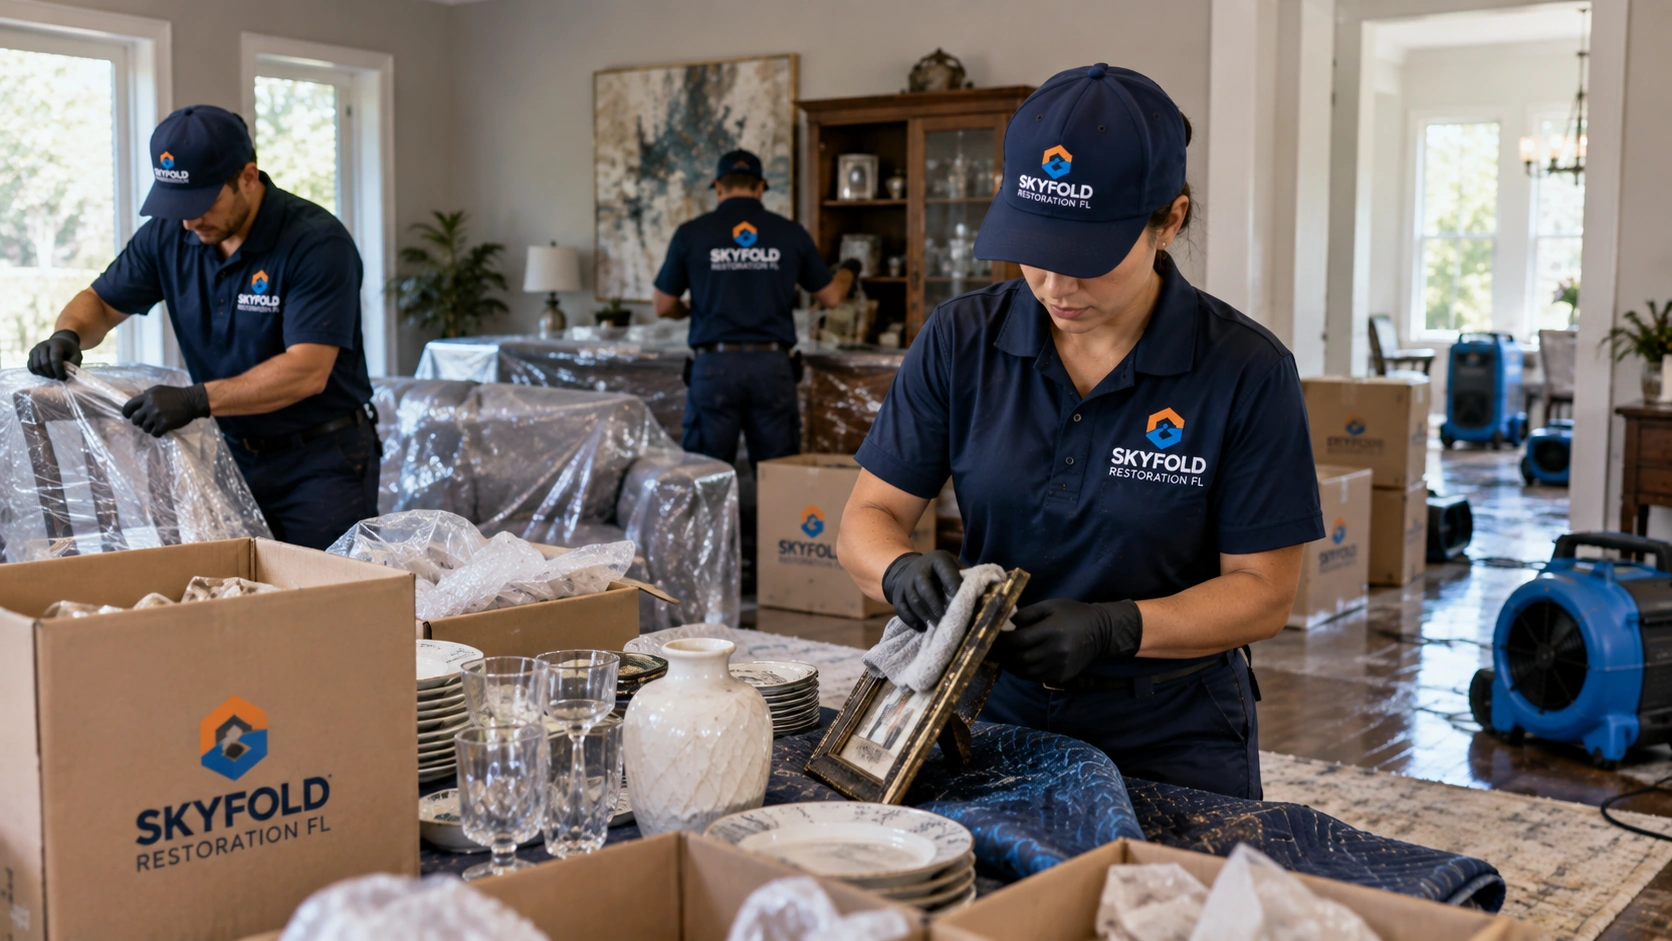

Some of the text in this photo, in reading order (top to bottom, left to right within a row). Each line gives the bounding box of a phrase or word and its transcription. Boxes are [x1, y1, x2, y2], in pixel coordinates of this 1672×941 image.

[1019, 174, 1093, 199] SKYFOLD
[1017, 189, 1091, 209] RESTORATION FL
[709, 247, 781, 262] SKYFOLD
[238, 294, 280, 306] SKYFOLD
[1111, 447, 1207, 474] SKYFOLD
[1109, 467, 1204, 487] RESTORATION FL
[778, 540, 837, 560] SKYFOL
[136, 776, 330, 845] SKYFOLD
[136, 815, 331, 872] RESTORATION FL
